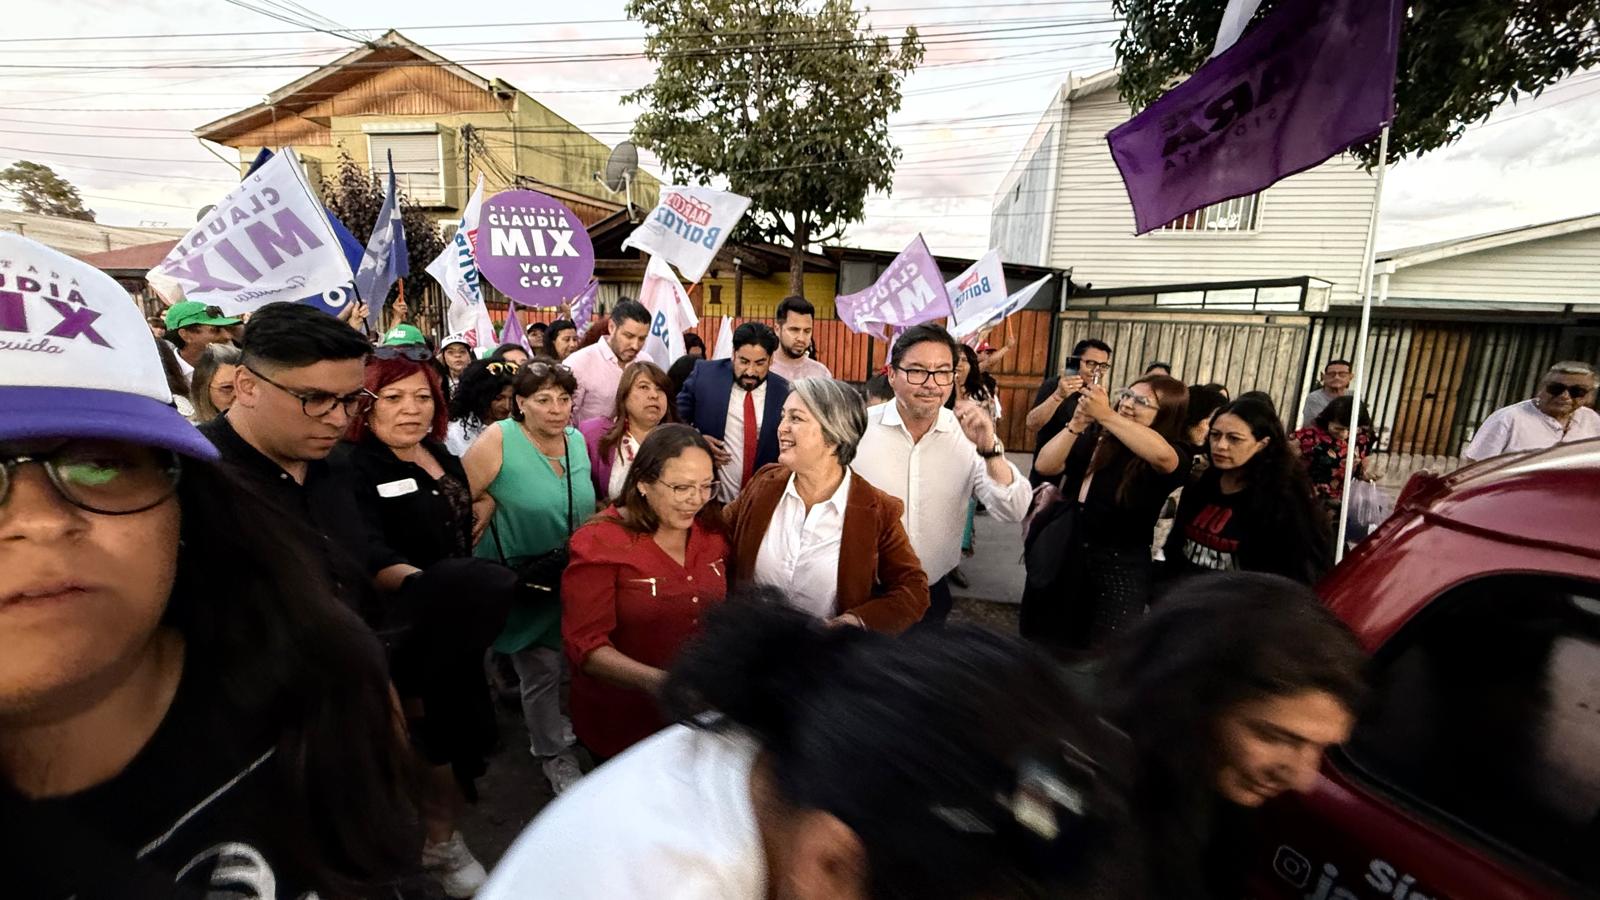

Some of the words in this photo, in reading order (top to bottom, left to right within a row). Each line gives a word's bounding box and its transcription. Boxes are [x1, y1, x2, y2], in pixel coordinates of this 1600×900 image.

[489, 205, 565, 215] DIPUTADA
[489, 213, 570, 228] CLAUDIA
[490, 227, 580, 257] MIX
[519, 263, 559, 274] Vota
[520, 275, 564, 288] C-67
